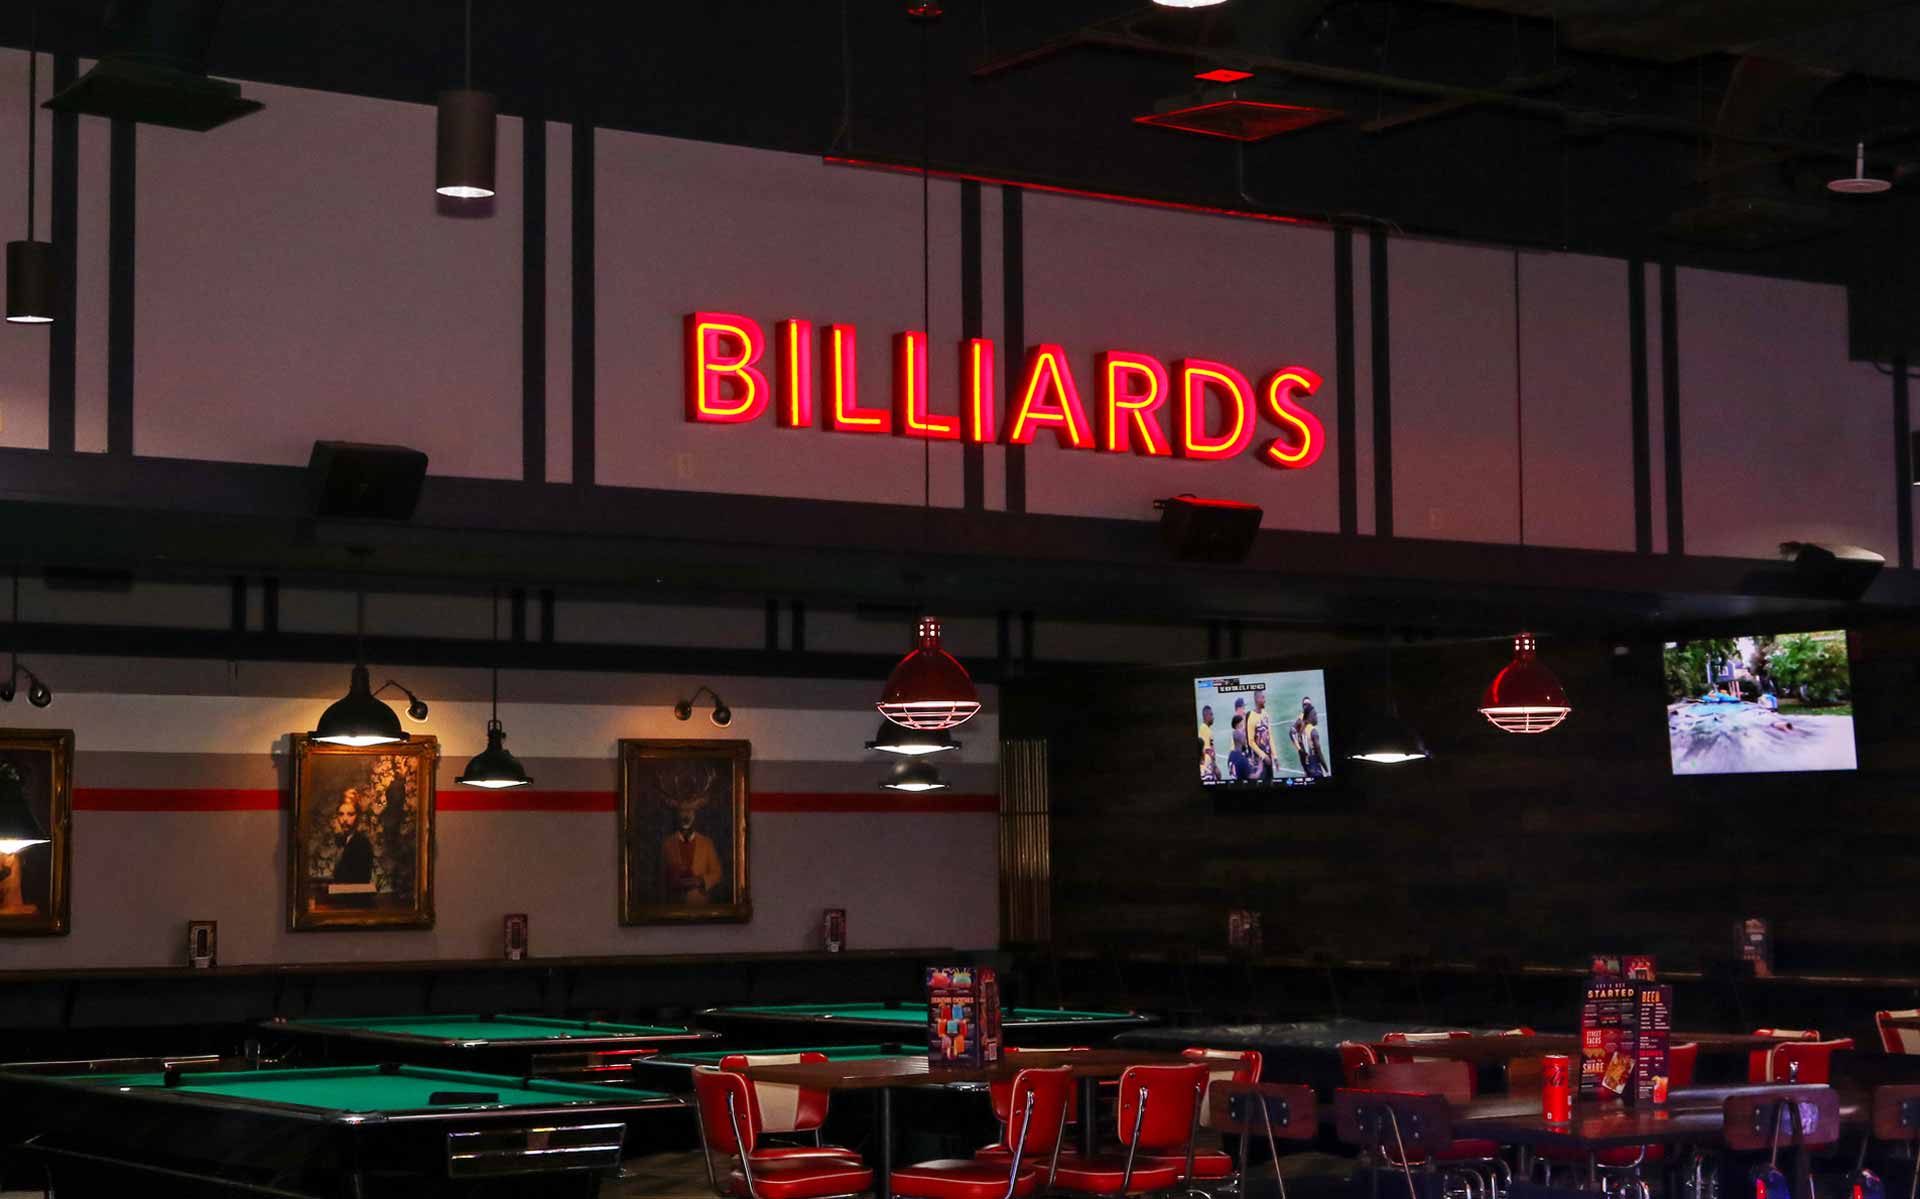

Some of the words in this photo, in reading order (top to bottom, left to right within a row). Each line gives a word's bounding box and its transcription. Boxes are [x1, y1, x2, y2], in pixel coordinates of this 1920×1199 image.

[686, 310, 1327, 470] BILLIARDS
[1587, 988, 1635, 998] STARTED
[1582, 1062, 1605, 1074] SHARE
